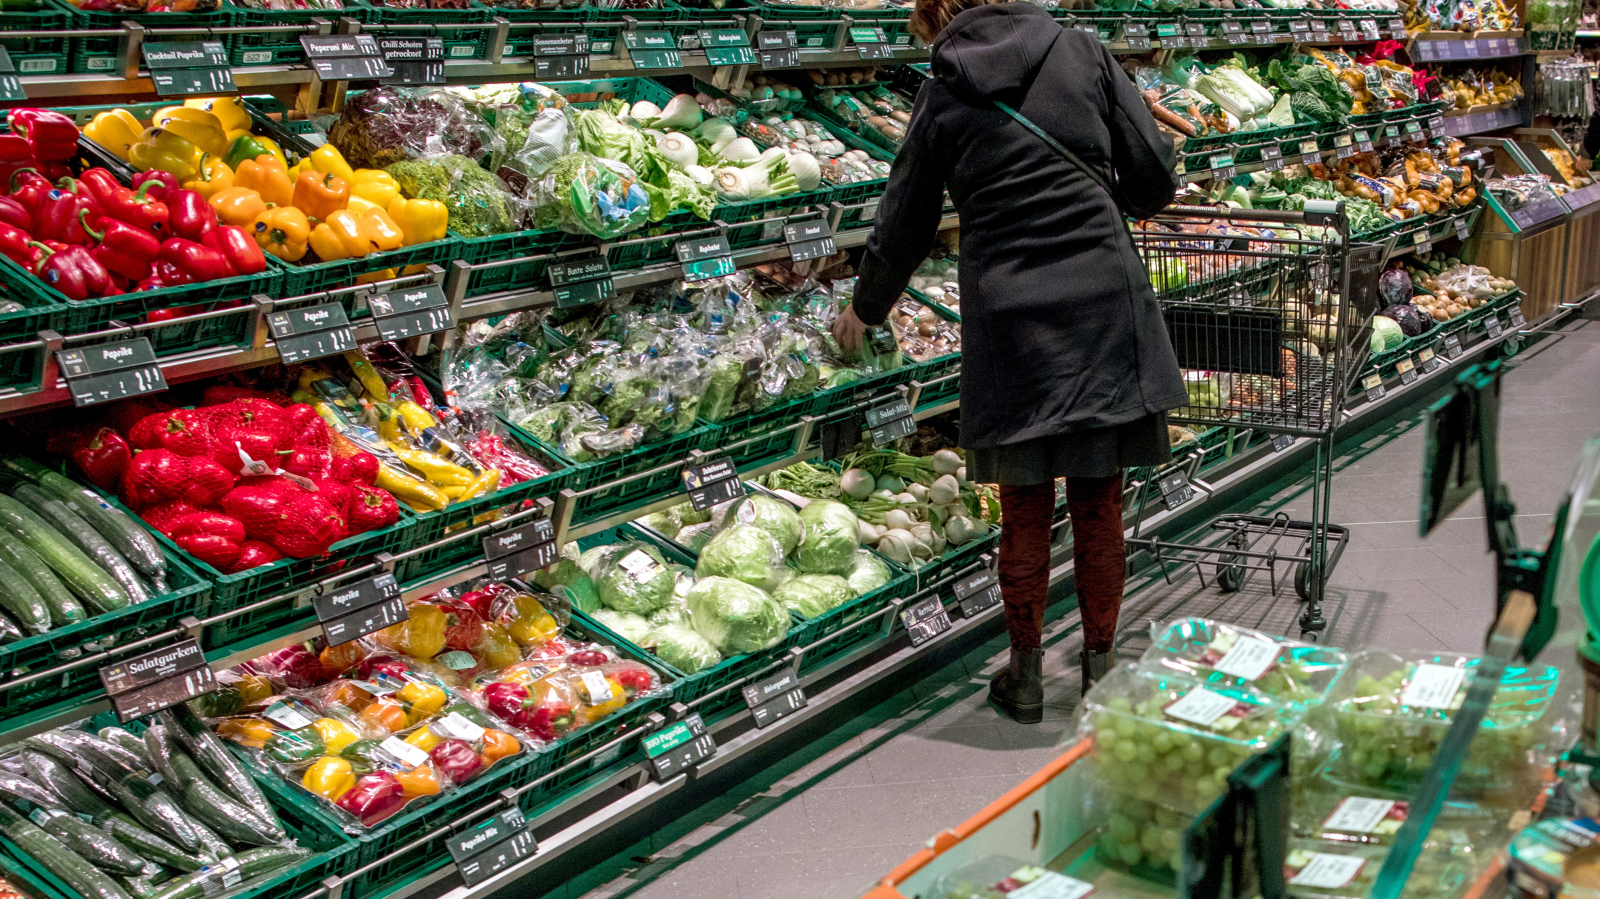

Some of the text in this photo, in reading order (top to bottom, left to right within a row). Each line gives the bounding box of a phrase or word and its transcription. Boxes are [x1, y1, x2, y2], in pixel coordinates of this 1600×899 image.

[310, 43, 355, 53] Peperoni Mix
[381, 40, 423, 48] Chilli Schoten
[535, 37, 573, 46] Sonnenanbeter
[147, 51, 205, 61] Cocktail Paprika
[385, 49, 422, 59] getrocknet
[567, 263, 603, 276] Bunte Salate
[404, 291, 428, 302] Paprika
[304, 310, 329, 322] Paprika
[103, 346, 133, 361] Paprika
[879, 404, 908, 419] Salat-Mix
[702, 463, 727, 475] Salatherzen
[500, 531, 522, 547] Paprika
[332, 590, 360, 605] Paprika
[918, 602, 935, 617] Rettich
[129, 644, 198, 675] Salatgurken
[645, 737, 660, 749] BIO
[660, 725, 687, 744] Paprika
[461, 827, 498, 851] Paprika Mix
